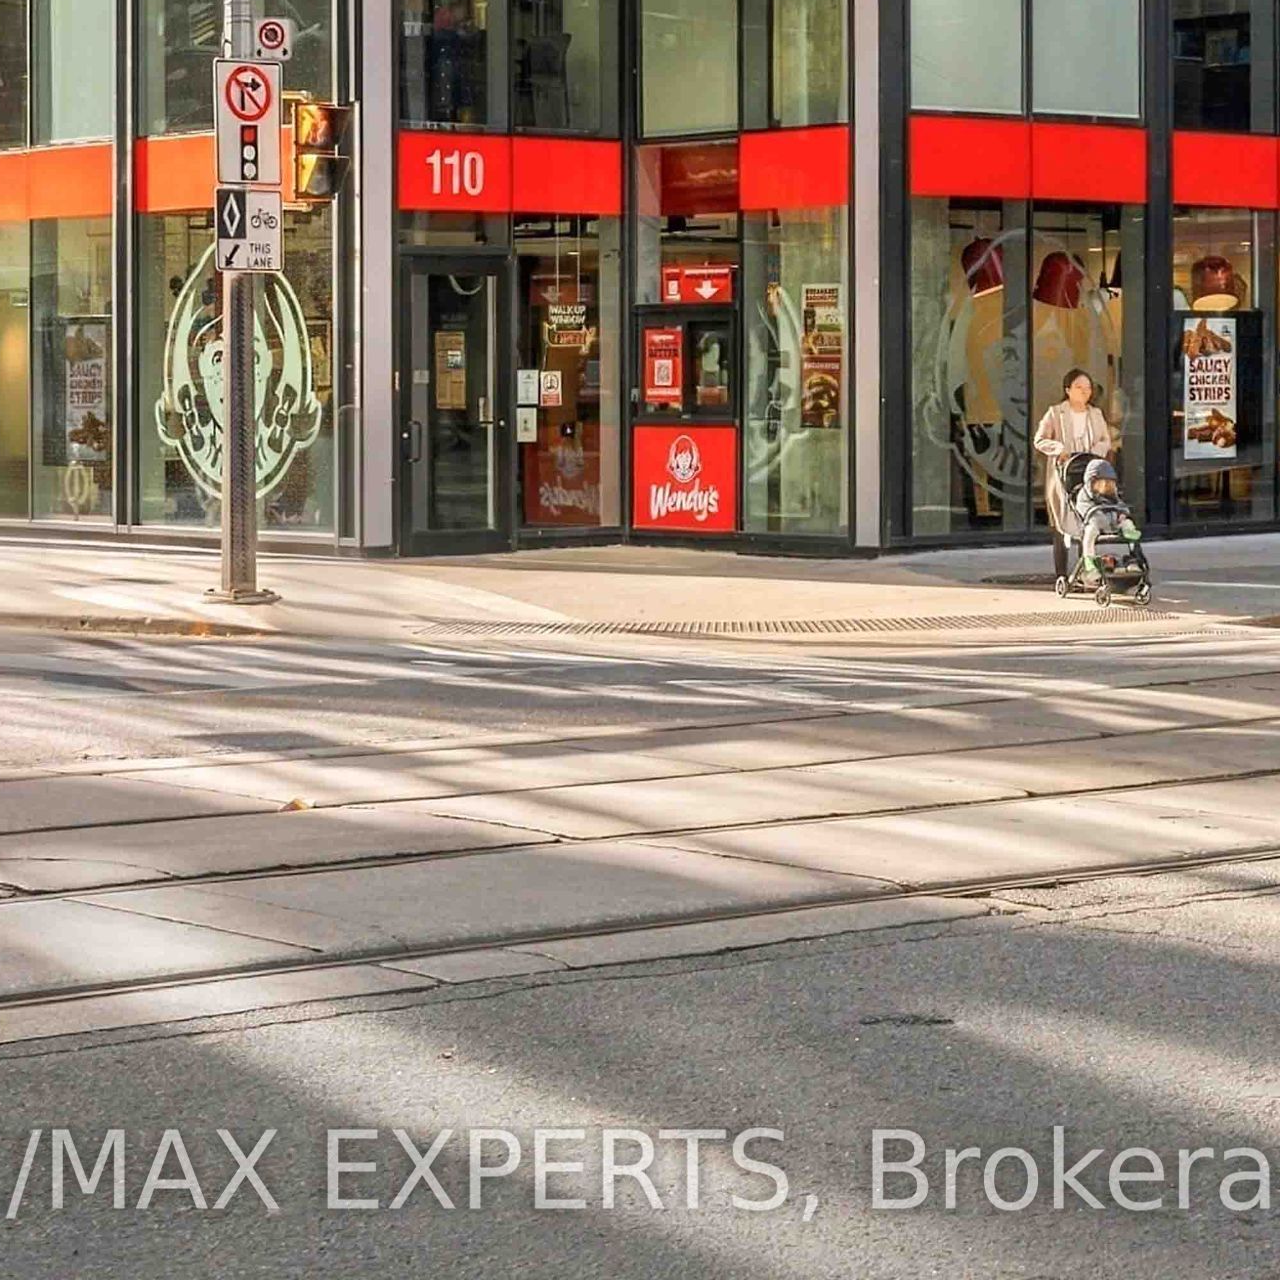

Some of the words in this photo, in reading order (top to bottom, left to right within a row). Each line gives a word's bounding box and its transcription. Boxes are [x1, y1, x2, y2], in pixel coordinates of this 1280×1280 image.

[426, 149, 484, 195] 110
[248, 243, 270, 254] THIS
[246, 256, 272, 268] LANE
[1189, 360, 1231, 373] SAUCY
[1189, 375, 1231, 385] CHICKEN
[1189, 387, 1231, 401] STRIPS
[650, 478, 719, 522] Wendy's
